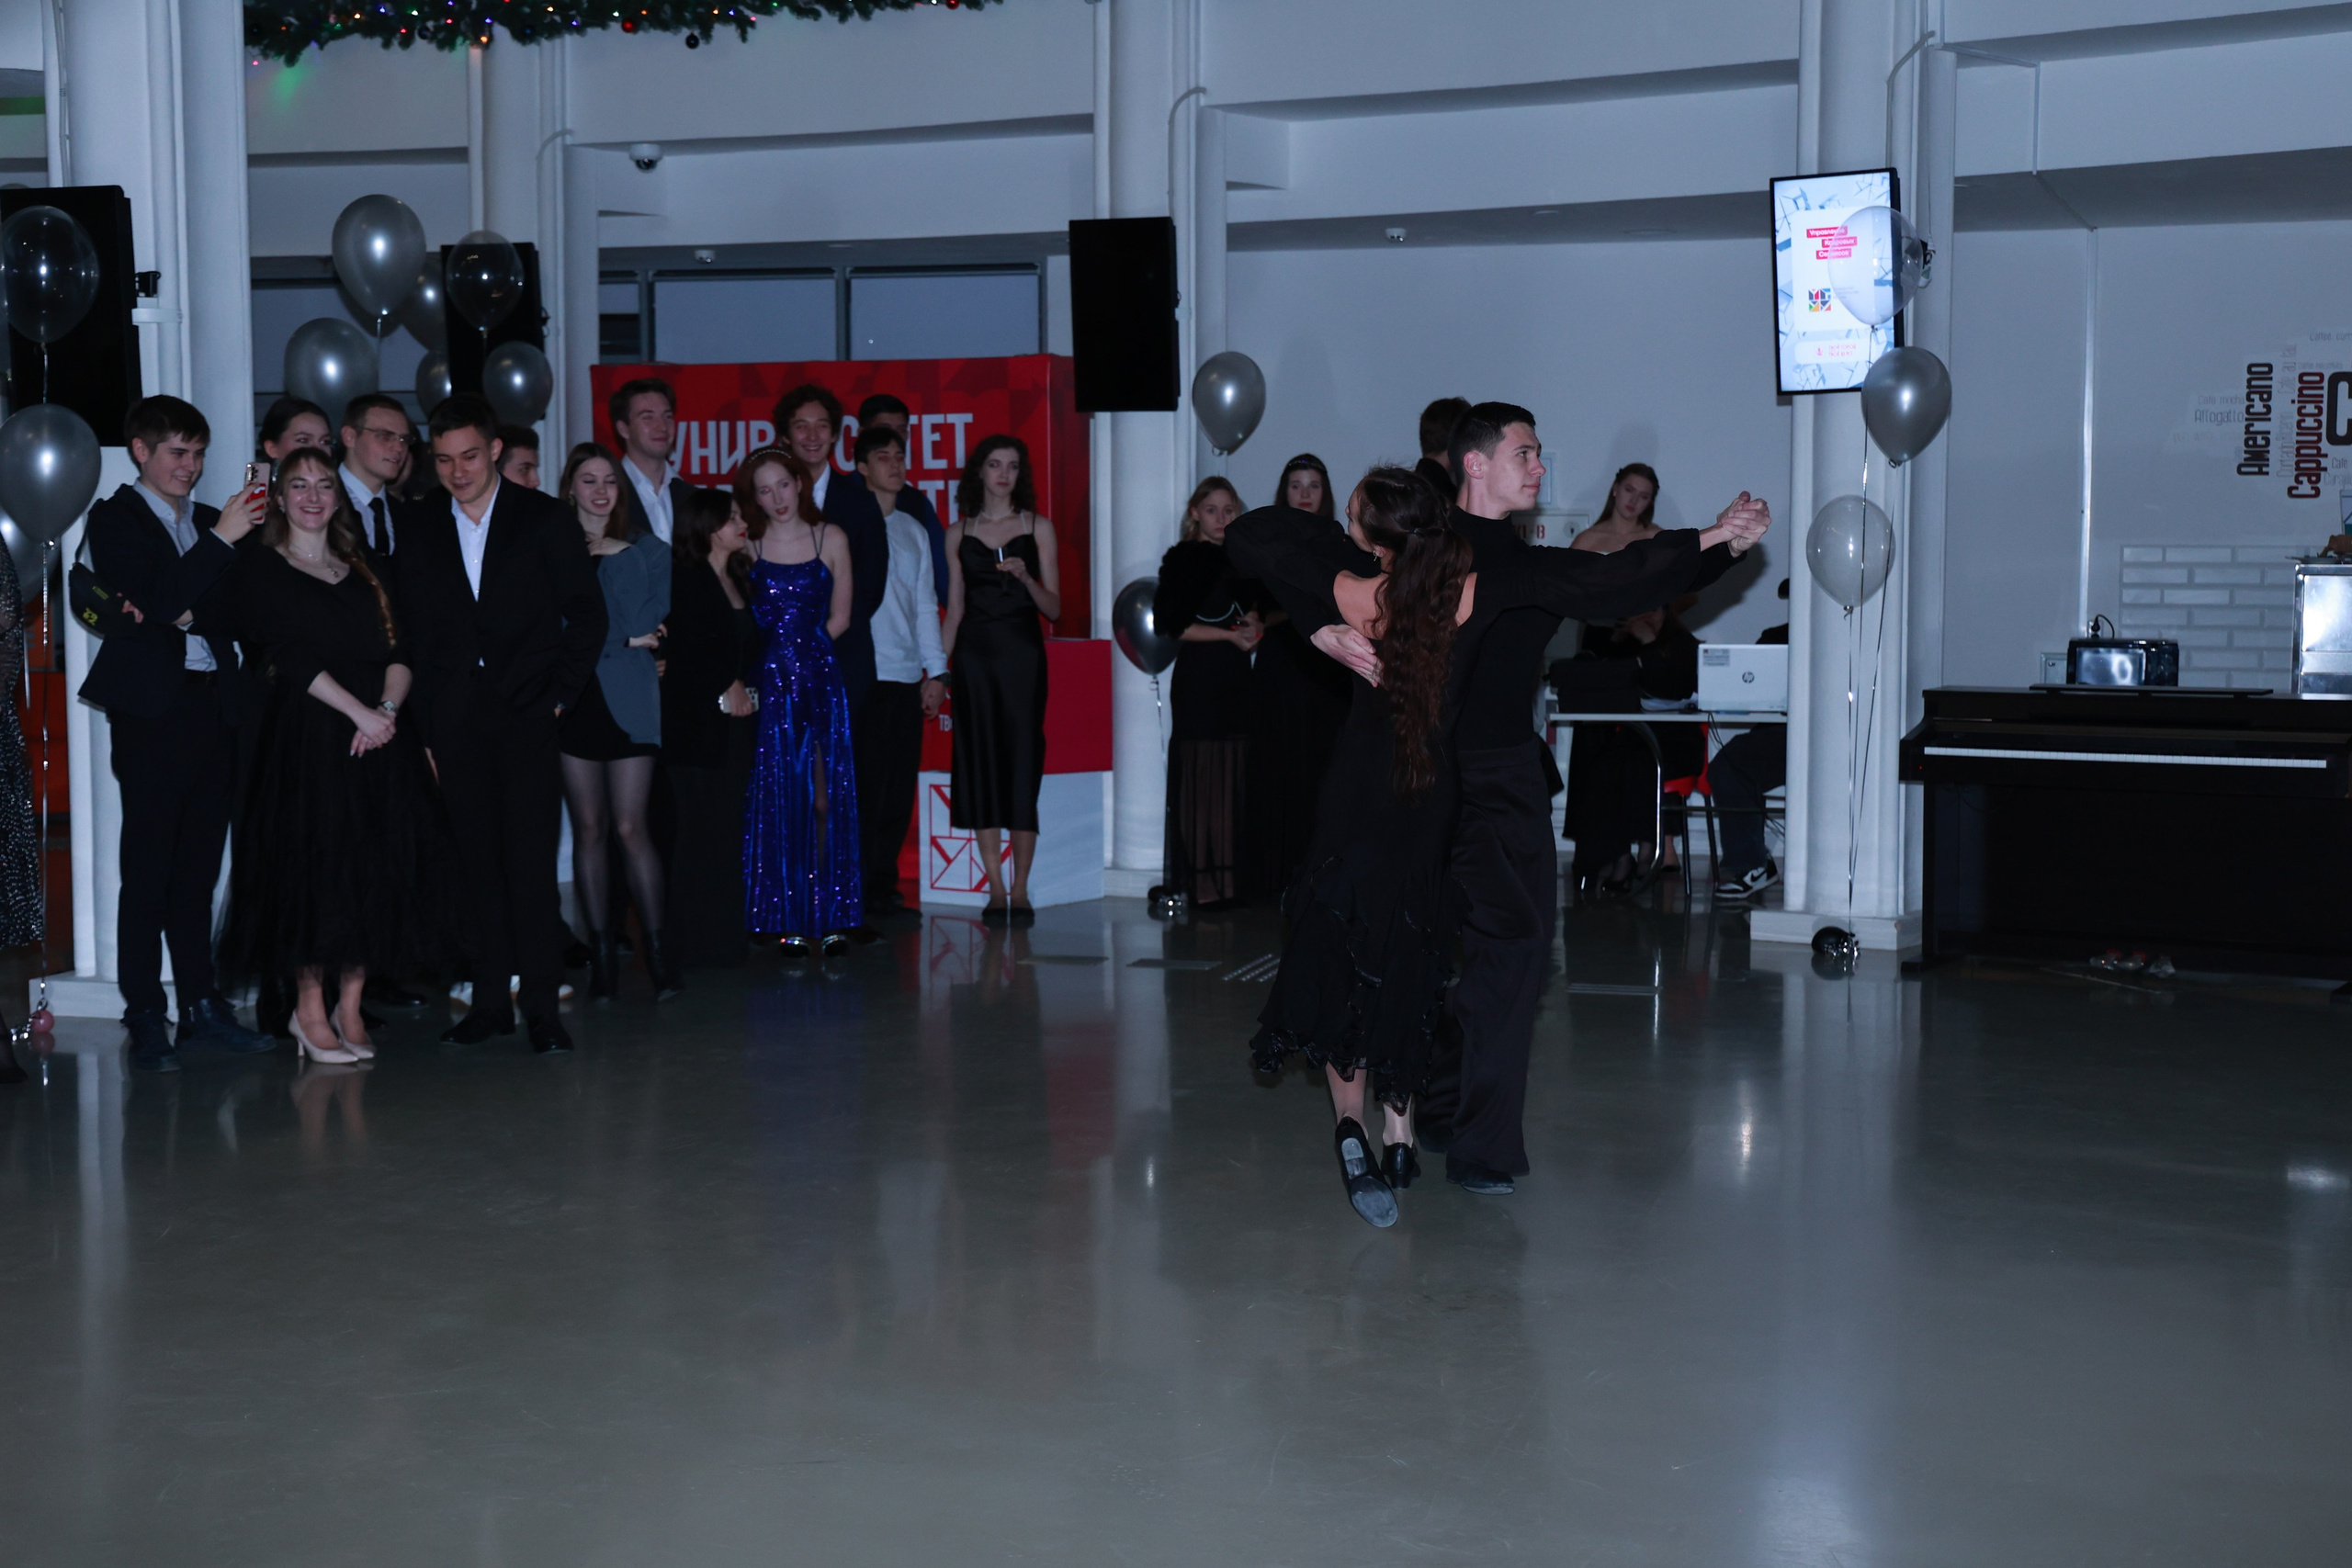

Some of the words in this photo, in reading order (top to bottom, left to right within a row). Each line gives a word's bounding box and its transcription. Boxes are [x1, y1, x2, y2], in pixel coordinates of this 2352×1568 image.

[669, 412, 974, 476] УНИВСТЕТ
[2236, 362, 2274, 476] Americano
[2287, 371, 2328, 499] Cappuccino
